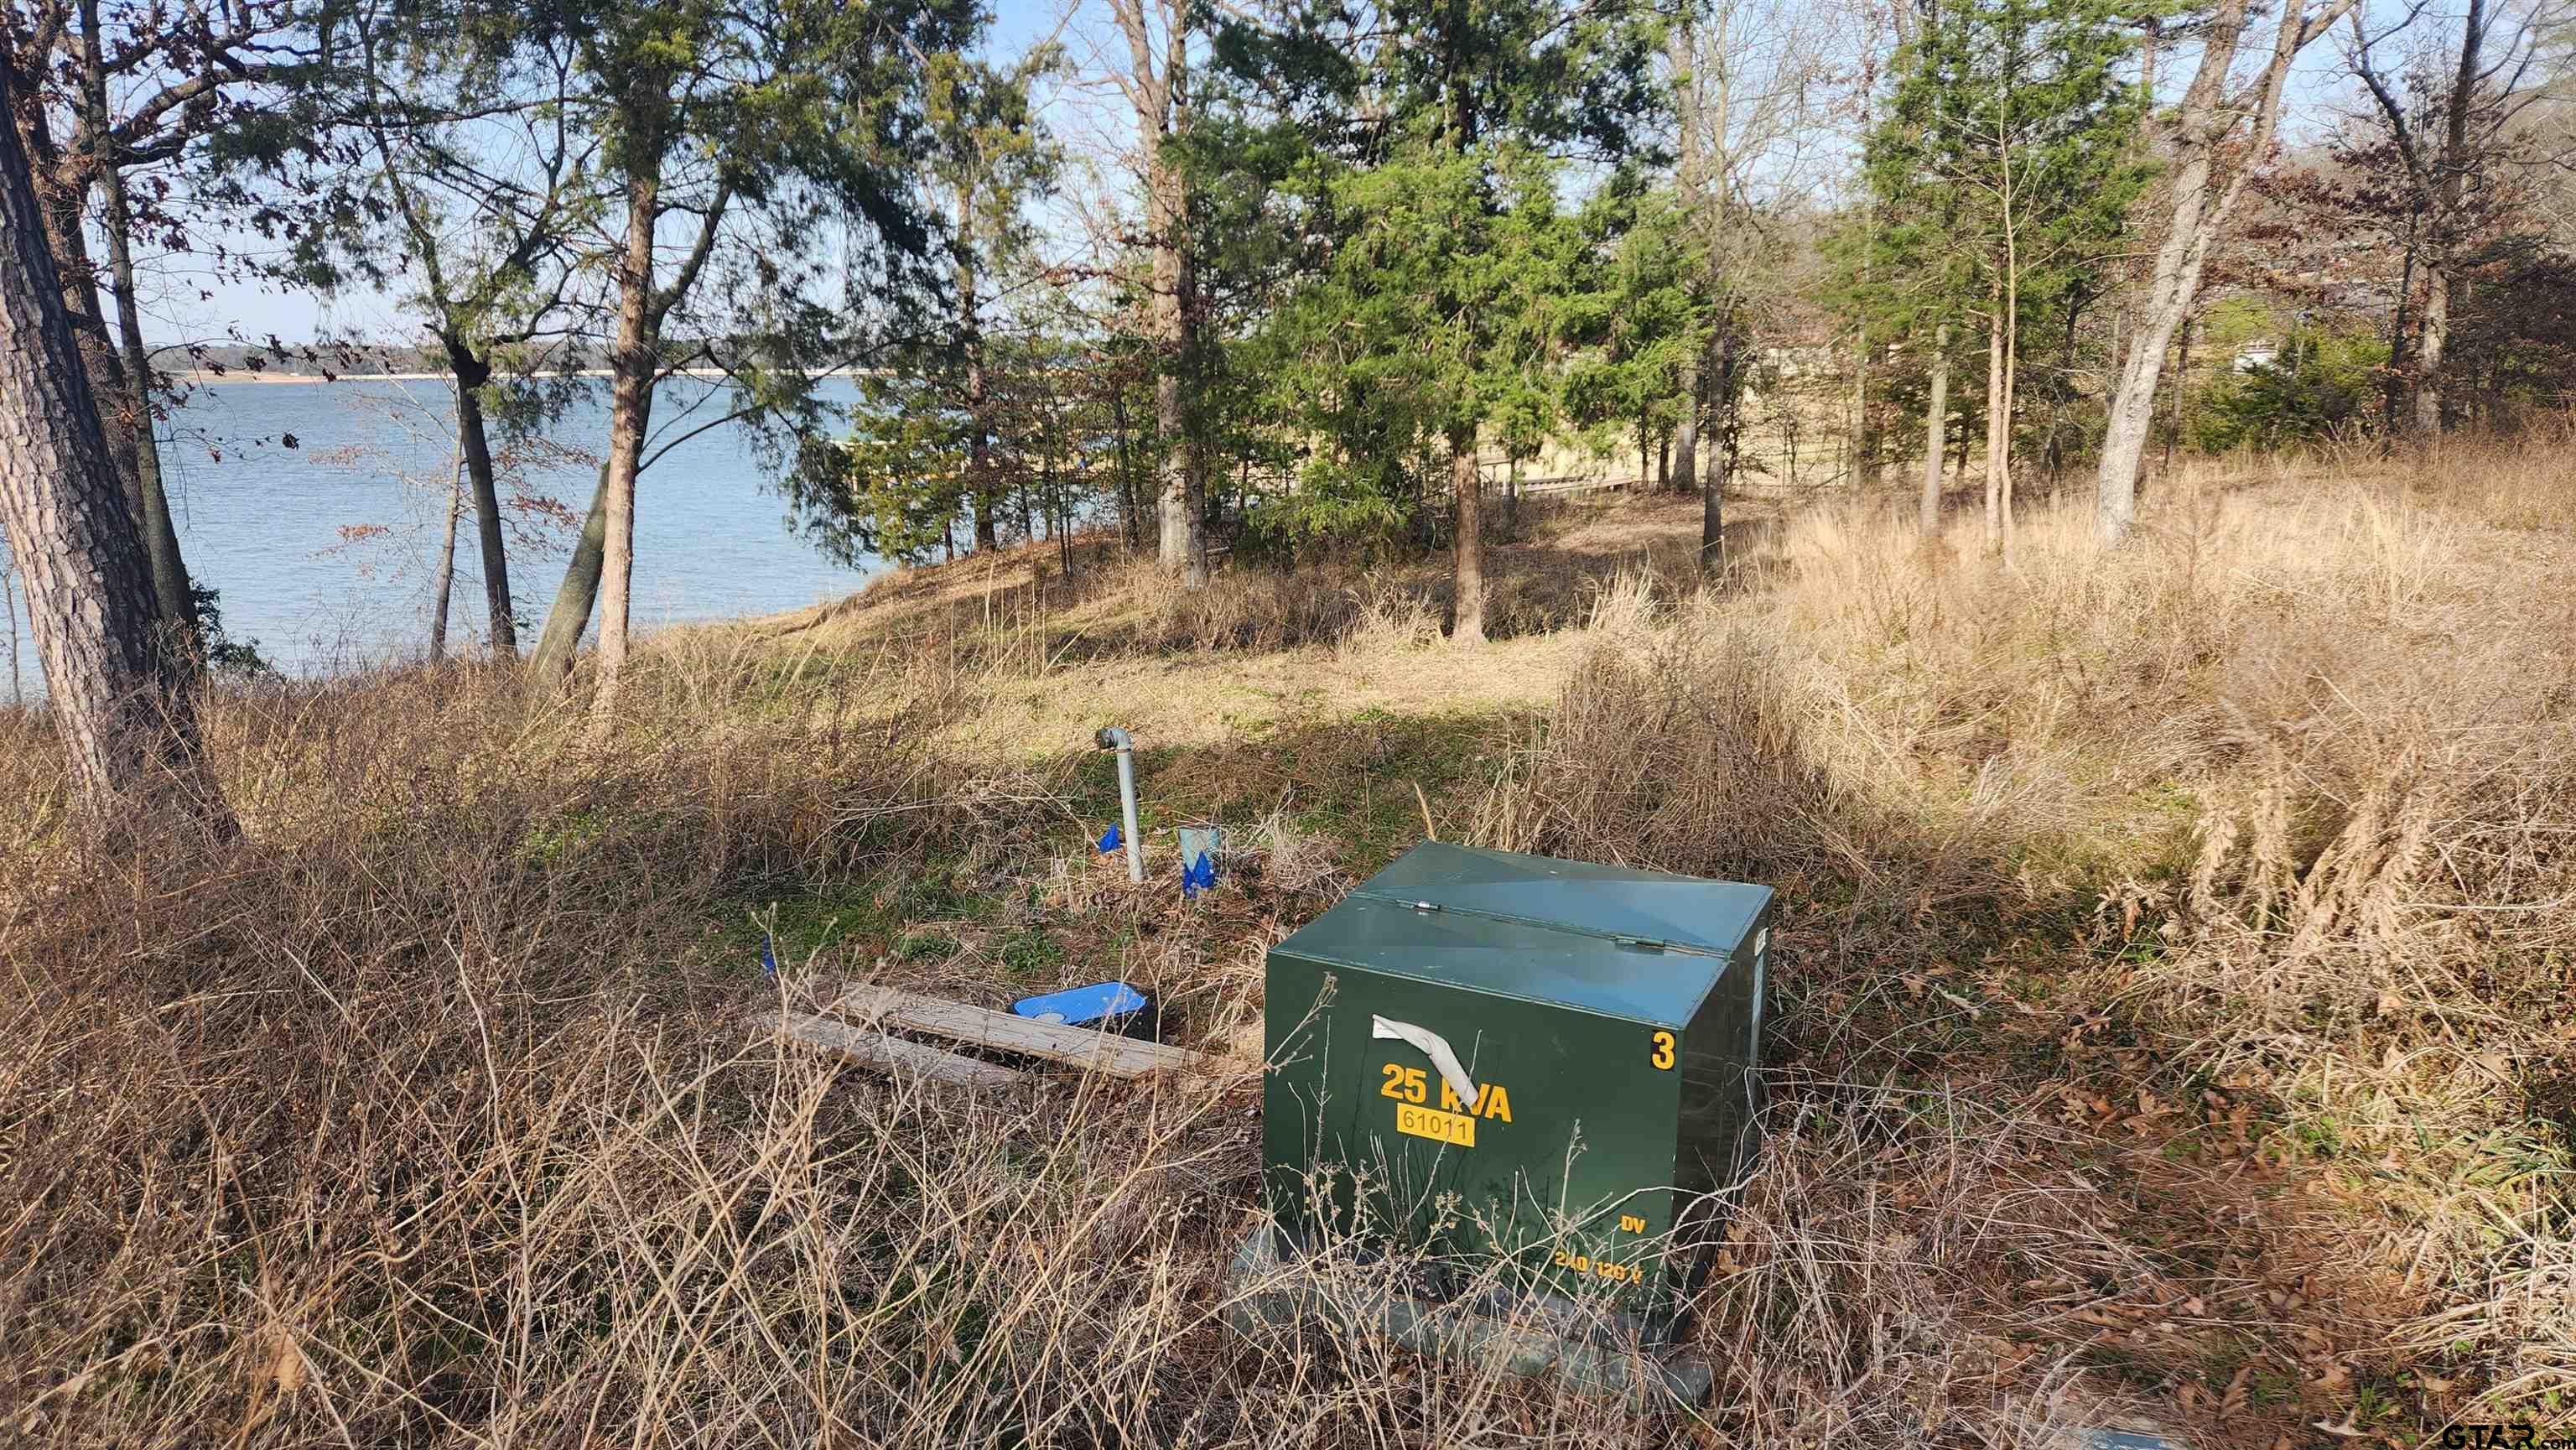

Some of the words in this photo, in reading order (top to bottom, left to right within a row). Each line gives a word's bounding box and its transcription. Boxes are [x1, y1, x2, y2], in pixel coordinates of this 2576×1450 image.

[1652, 1031, 1675, 1070] 3
[1381, 1063, 1427, 1104] 25
[1402, 1110, 1468, 1141] 61011
[1621, 1214, 1645, 1234] DV
